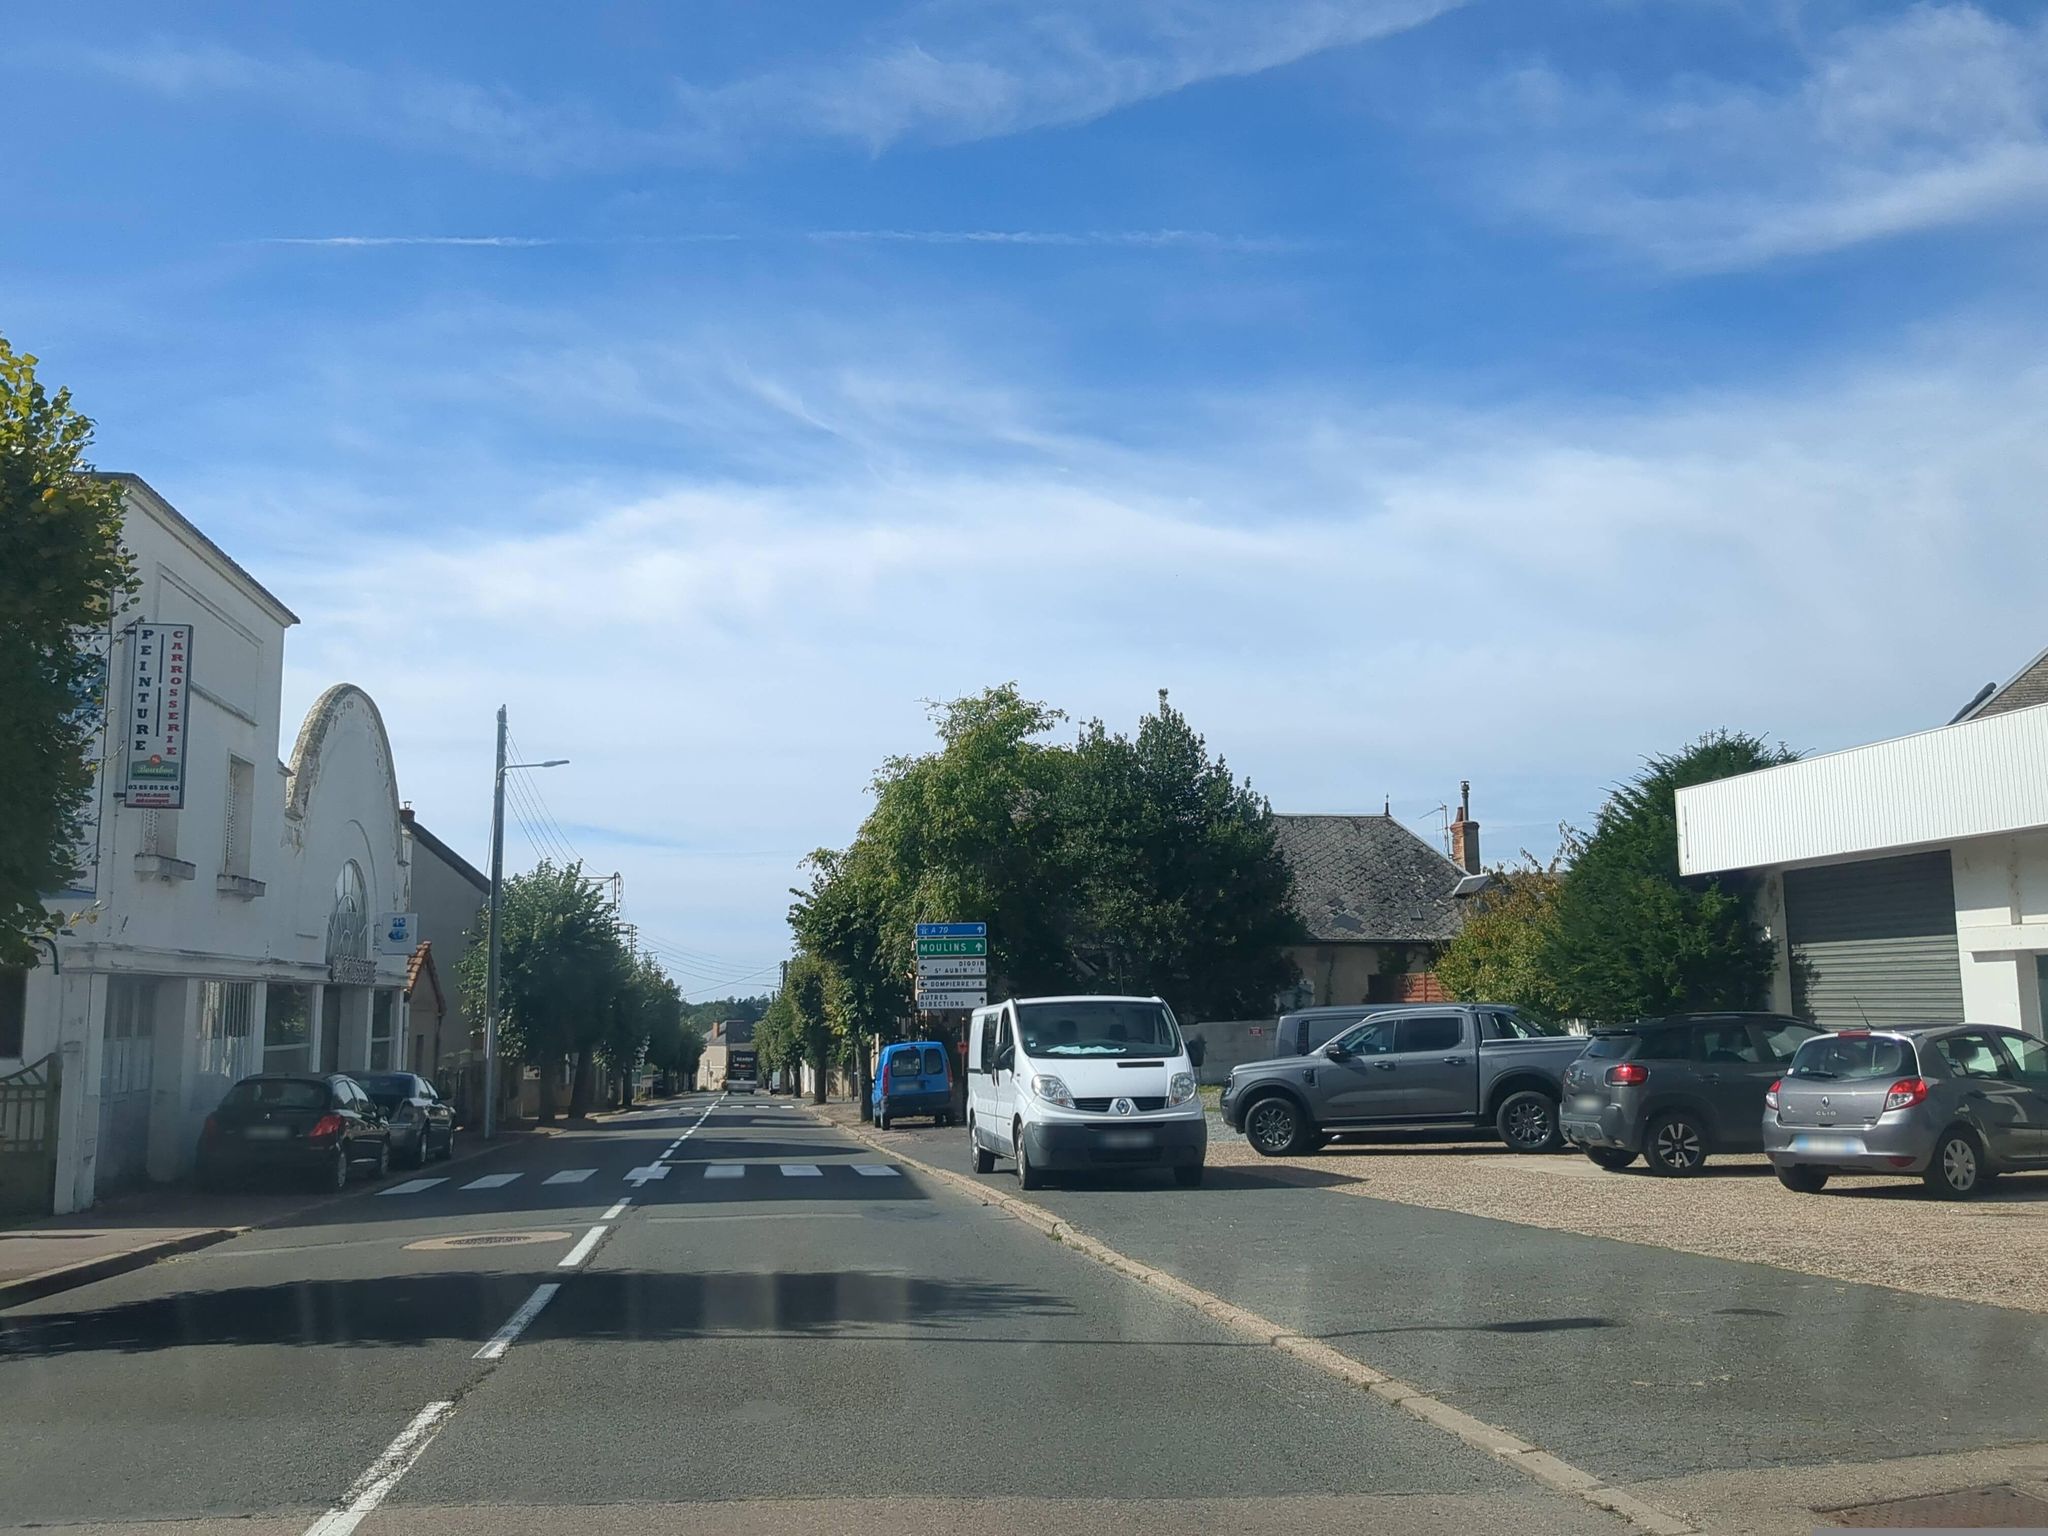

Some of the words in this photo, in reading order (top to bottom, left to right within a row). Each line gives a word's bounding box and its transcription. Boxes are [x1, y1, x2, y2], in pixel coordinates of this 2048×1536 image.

[135, 629, 154, 750] PEINTURE
[166, 630, 184, 755] CARROSSERIE
[920, 943, 967, 952] MOULINS
